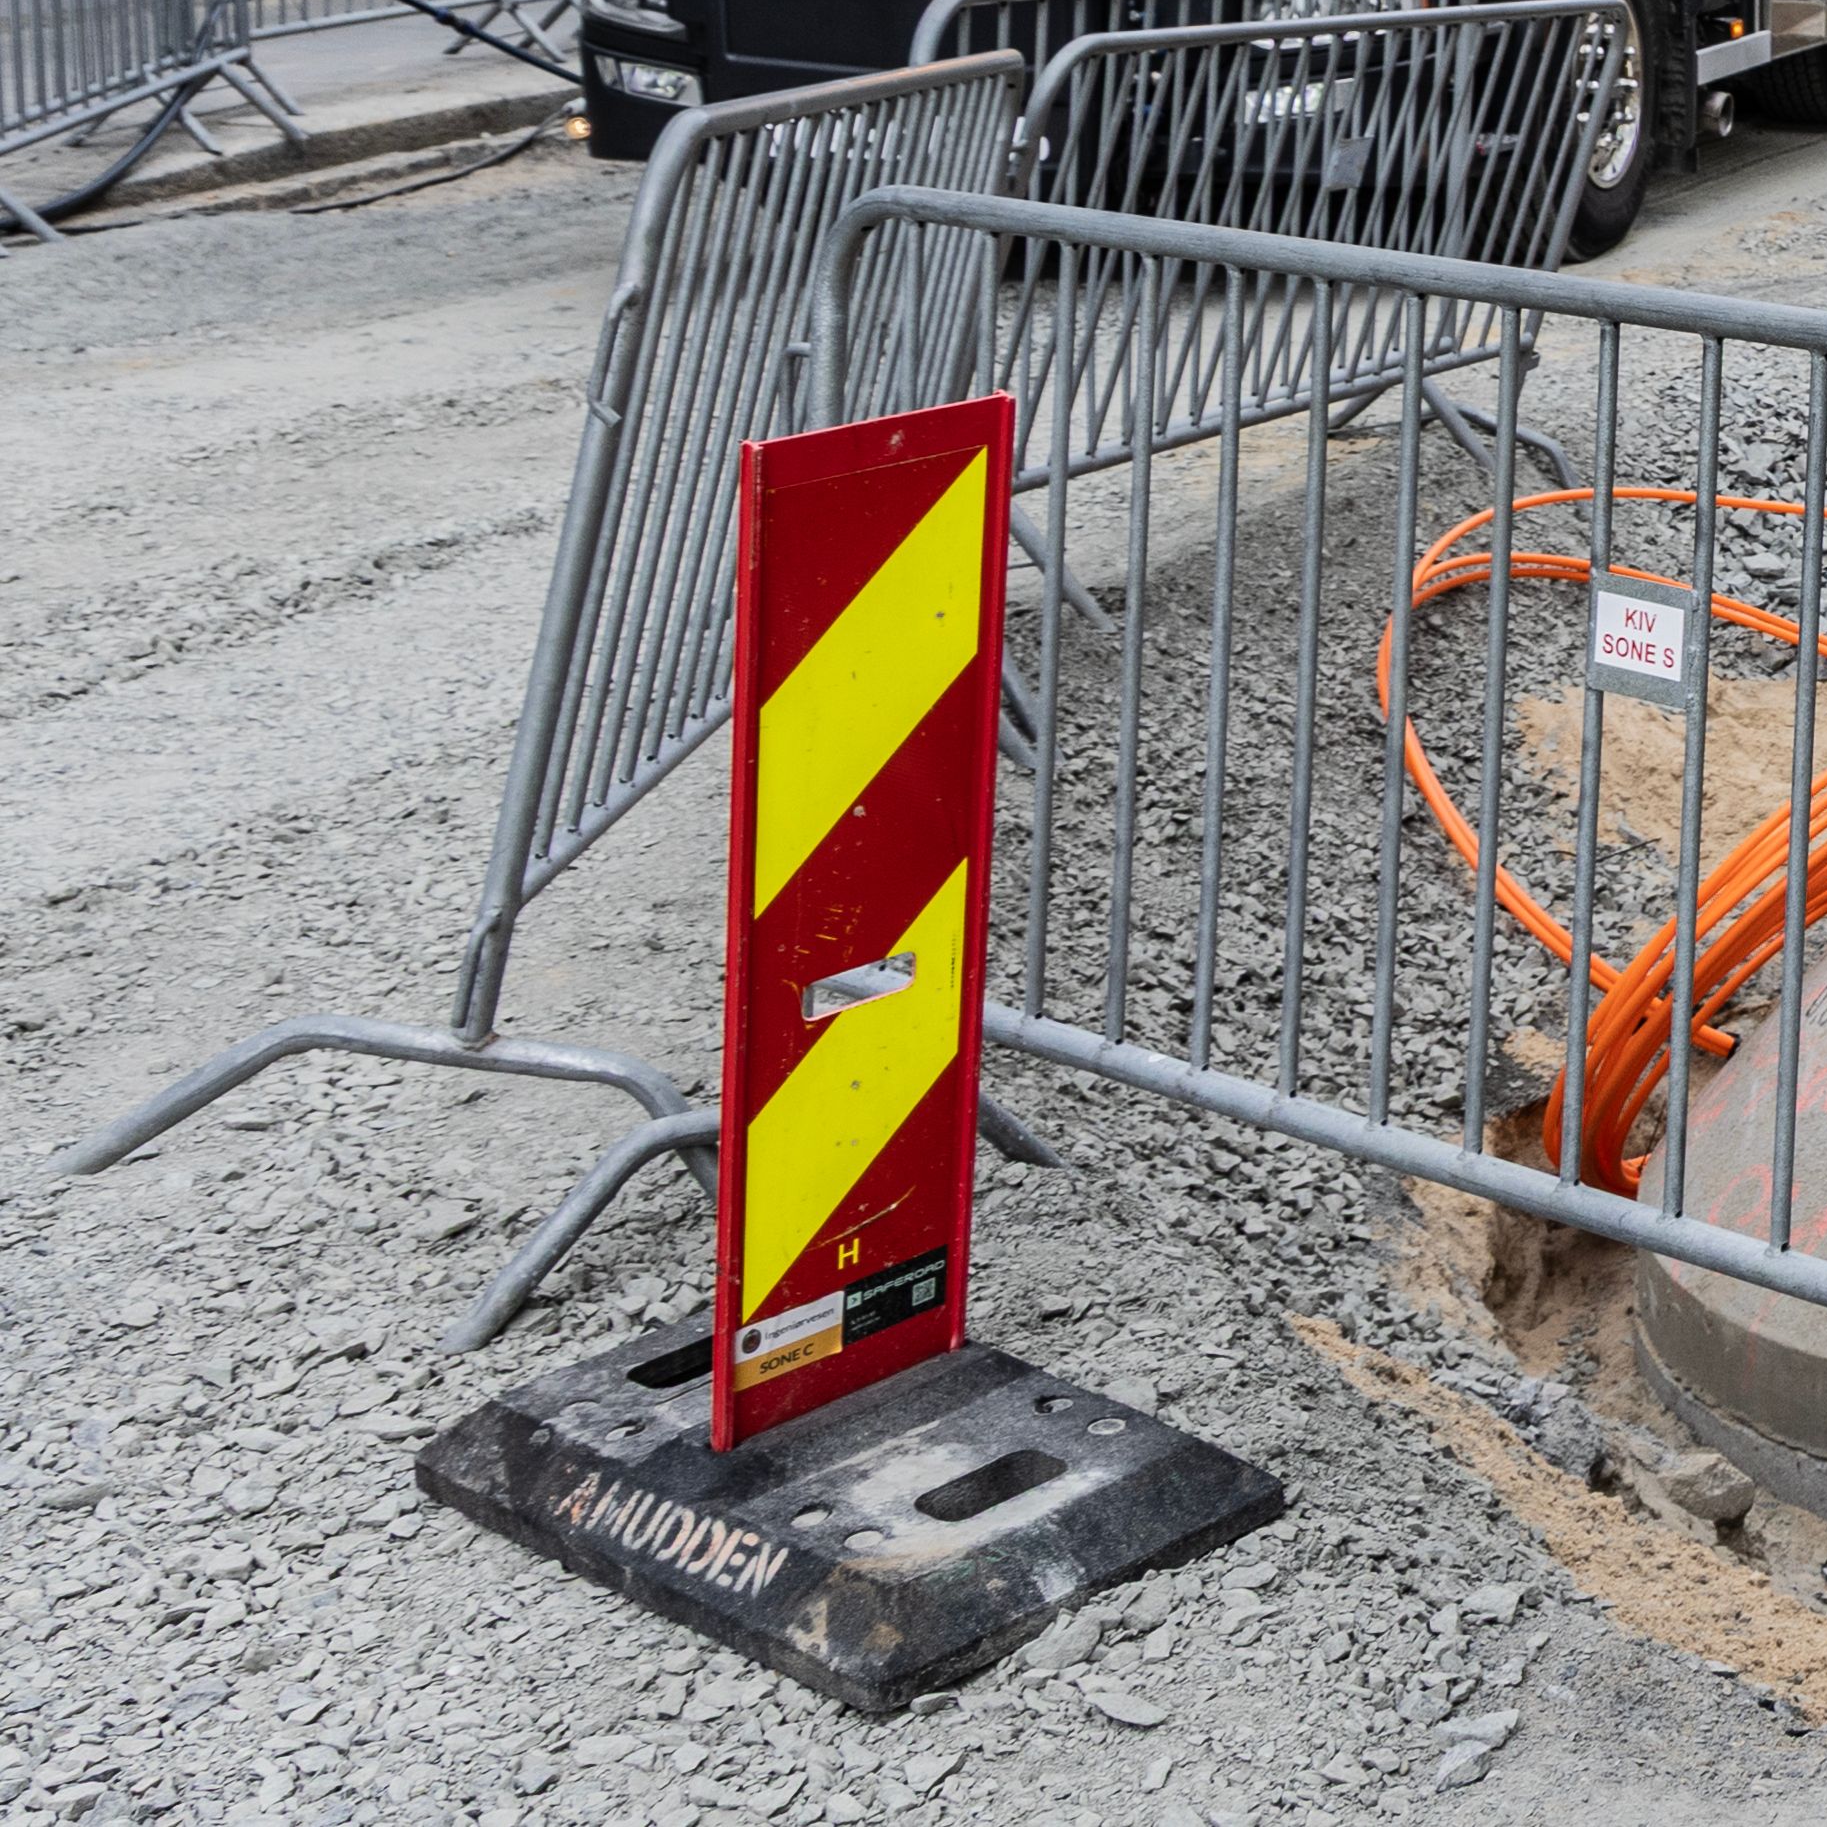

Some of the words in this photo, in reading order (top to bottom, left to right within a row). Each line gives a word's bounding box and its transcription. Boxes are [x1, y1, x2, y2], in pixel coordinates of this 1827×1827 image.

[1624, 607, 1658, 634] KIV
[1602, 633, 1657, 665] SONE
[1662, 647, 1675, 669] S
[837, 1237, 860, 1270] H
[862, 1259, 946, 1301] SAFEROAD
[759, 1347, 801, 1374] SONE
[802, 1342, 815, 1357] C
